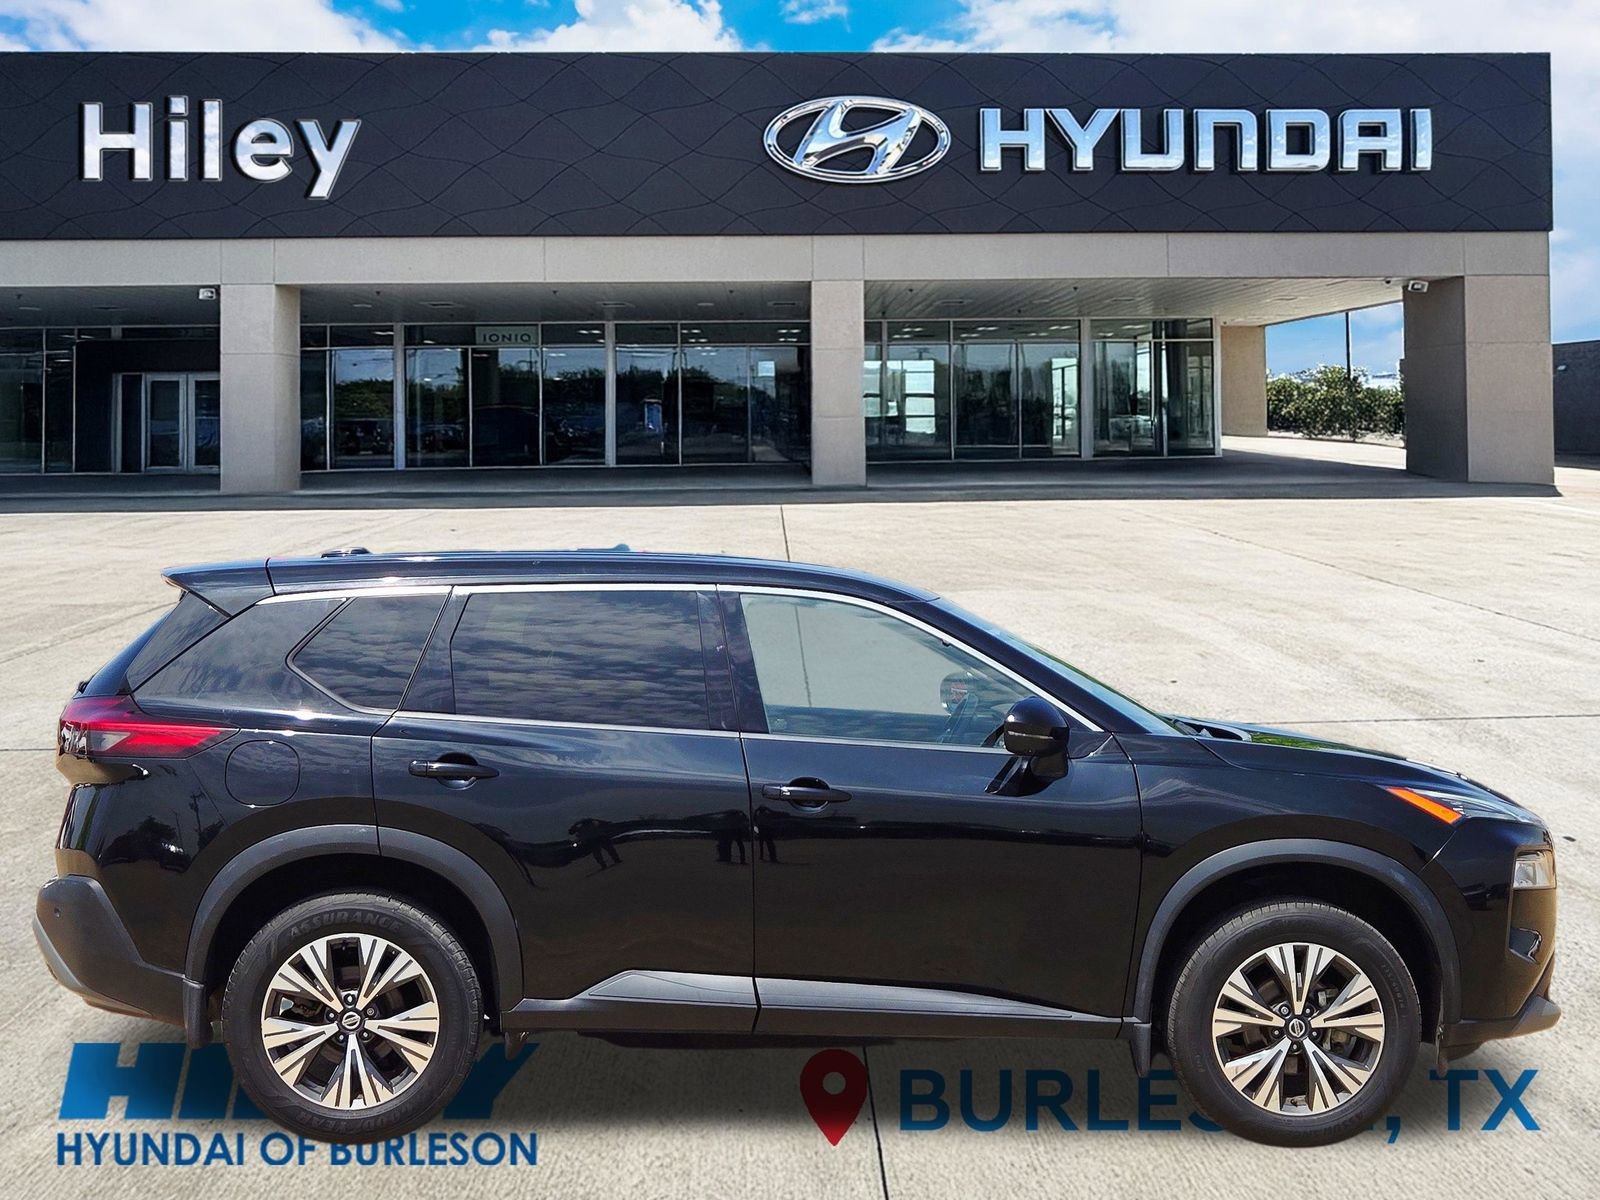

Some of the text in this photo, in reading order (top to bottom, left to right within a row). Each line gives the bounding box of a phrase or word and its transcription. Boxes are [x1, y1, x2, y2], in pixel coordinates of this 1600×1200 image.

[79, 95, 362, 200] Hiley
[979, 107, 1432, 172] HYUNDAI
[483, 333, 531, 343] IONIQ
[290, 911, 404, 937] ASSURANCE
